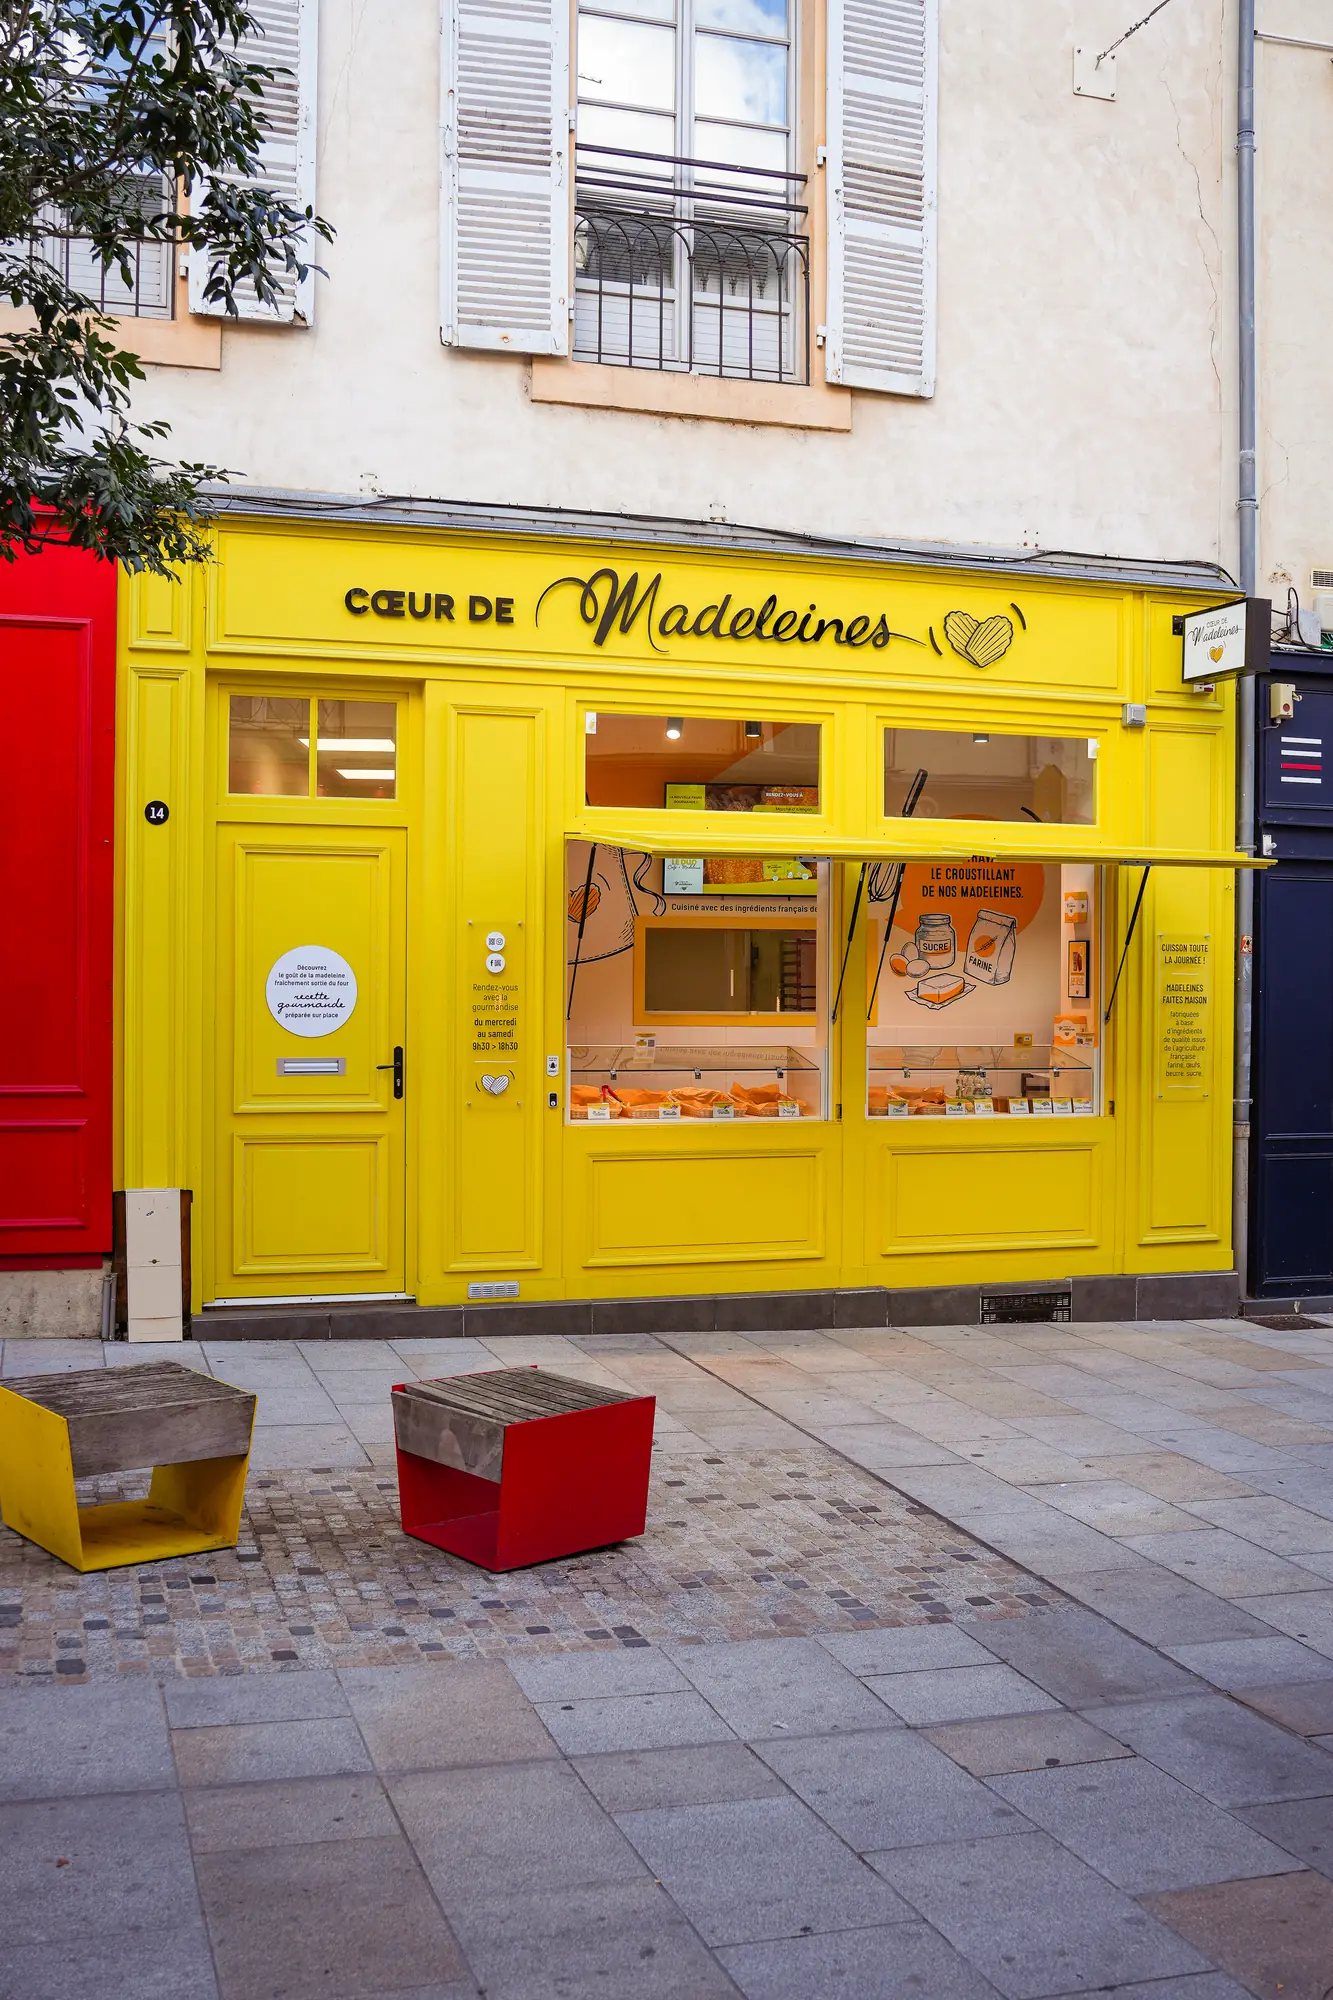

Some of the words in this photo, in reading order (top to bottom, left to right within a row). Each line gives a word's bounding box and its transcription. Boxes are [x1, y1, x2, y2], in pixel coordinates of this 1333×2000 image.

[344, 587, 455, 621] CŒUR
[468, 595, 514, 624] DE
[535, 568, 926, 653] Madeleines
[1221, 617, 1228, 625] DE
[1187, 624, 1244, 646] Madeleines
[150, 807, 164, 819] 14
[931, 868, 941, 880] LE
[946, 868, 1015, 880] CROUSTILLANT
[922, 886, 934, 897] DE
[938, 886, 957, 897] NOS
[961, 886, 1023, 898] MADELEINES.
[671, 903, 699, 911] Cuisiné
[720, 904, 733, 912] des
[735, 904, 776, 913] ingrédients
[778, 905, 808, 914] français
[922, 942, 949, 951] SUCRE
[1162, 944, 1187, 952] CUISSON
[968, 955, 993, 973] FARINE
[1165, 956, 1172, 964] LA
[1174, 955, 1201, 964] JOURNÉE
[1166, 984, 1203, 992] MADELEINES
[294, 992, 329, 1000] recette
[1163, 996, 1183, 1004] FAITES
[1185, 996, 1207, 1004] MAISON
[277, 998, 345, 1014] gourmande
[472, 1004, 519, 1012] gourmandise
[474, 1018, 483, 1026] du
[485, 1018, 517, 1026] mercredi
[1167, 1028, 1202, 1036] d'ingrédients
[473, 1042, 490, 1051] 9h30
[498, 1042, 518, 1051] 18h30
[1170, 1053, 1196, 1061] française
